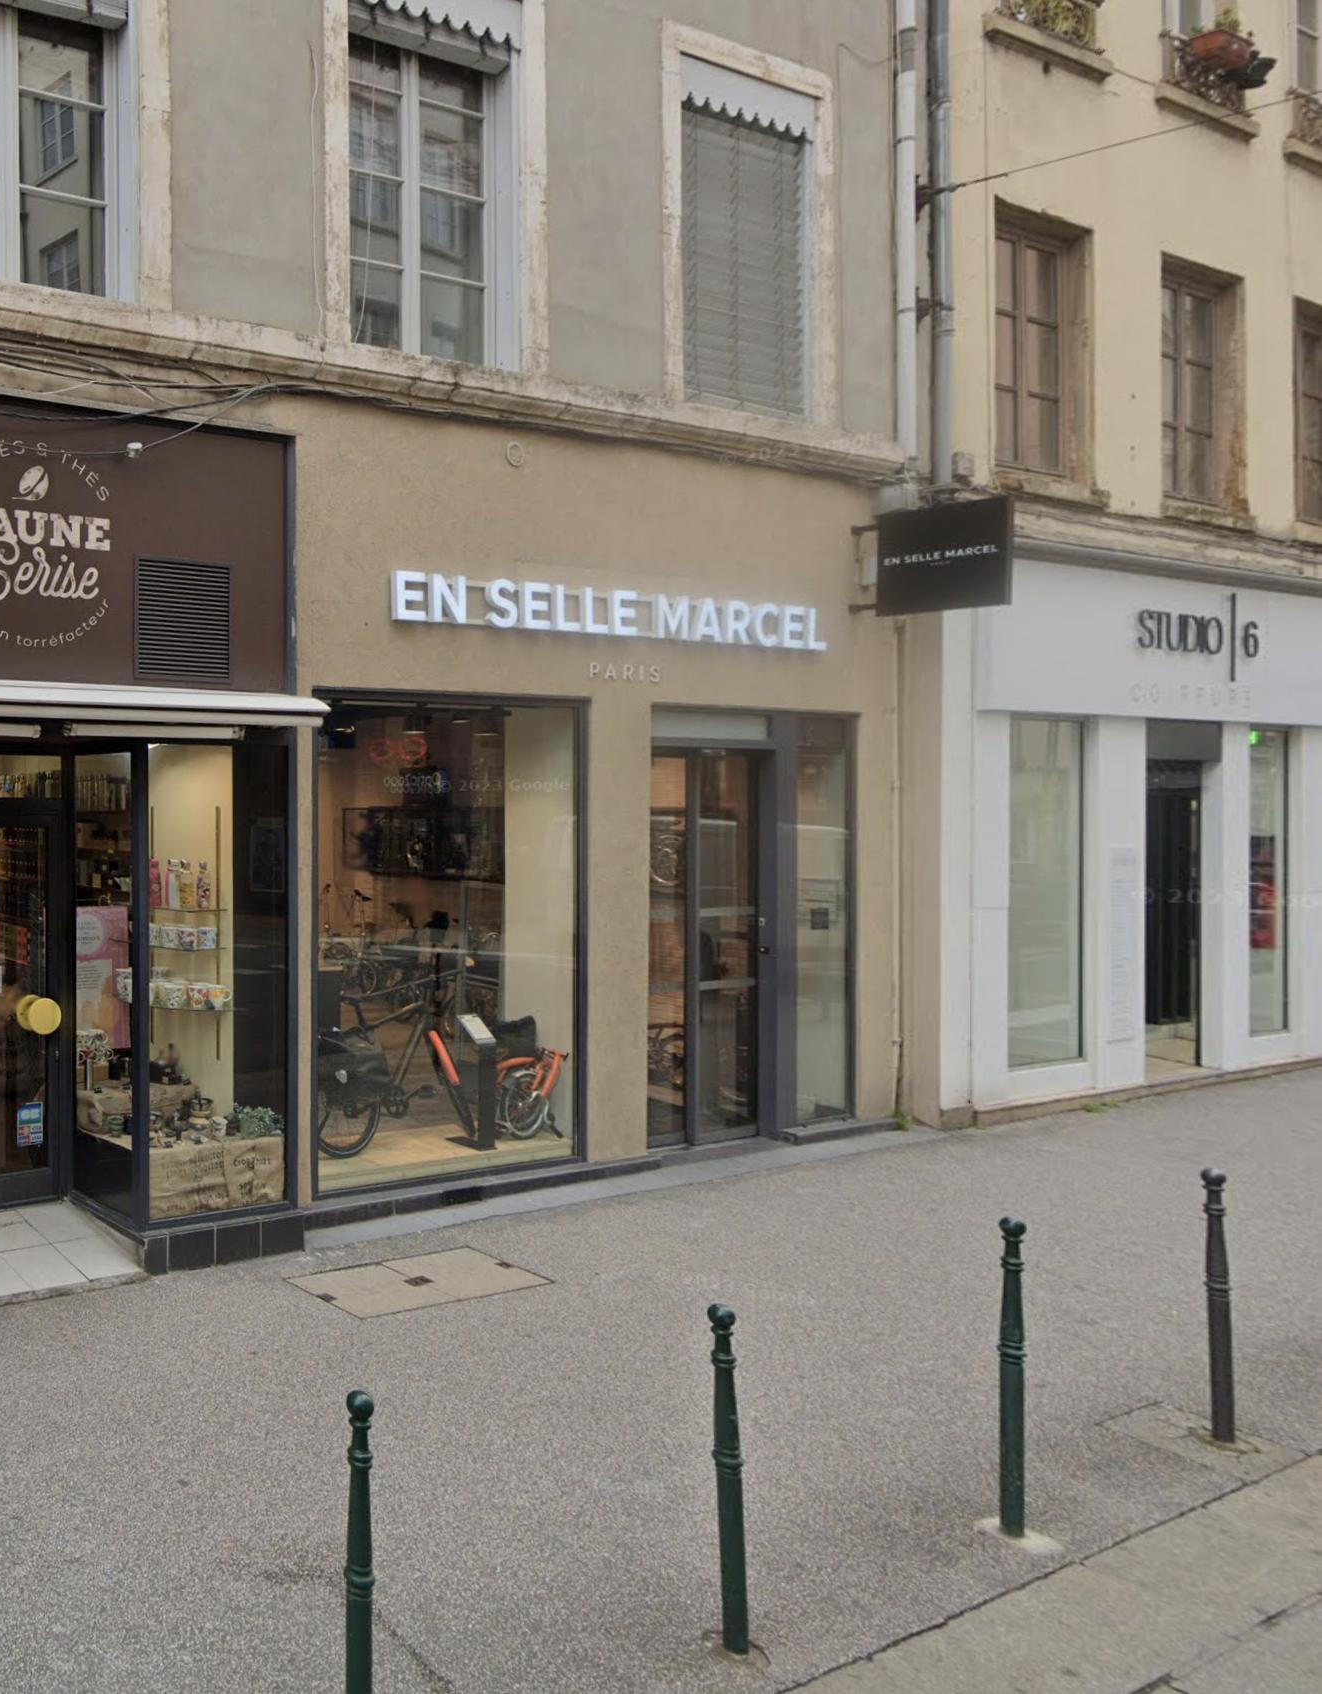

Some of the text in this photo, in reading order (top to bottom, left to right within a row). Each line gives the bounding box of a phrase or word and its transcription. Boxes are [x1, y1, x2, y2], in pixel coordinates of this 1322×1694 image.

[60, 449, 111, 502] THÉS
[884, 544, 998, 566] EN SELLE MARCEL
[16, 598, 110, 649] torréfacteur
[391, 570, 827, 651] EN SELLE MARCEL
[1137, 609, 1259, 658] STUDIO 6
[589, 662, 661, 682] PARIS
